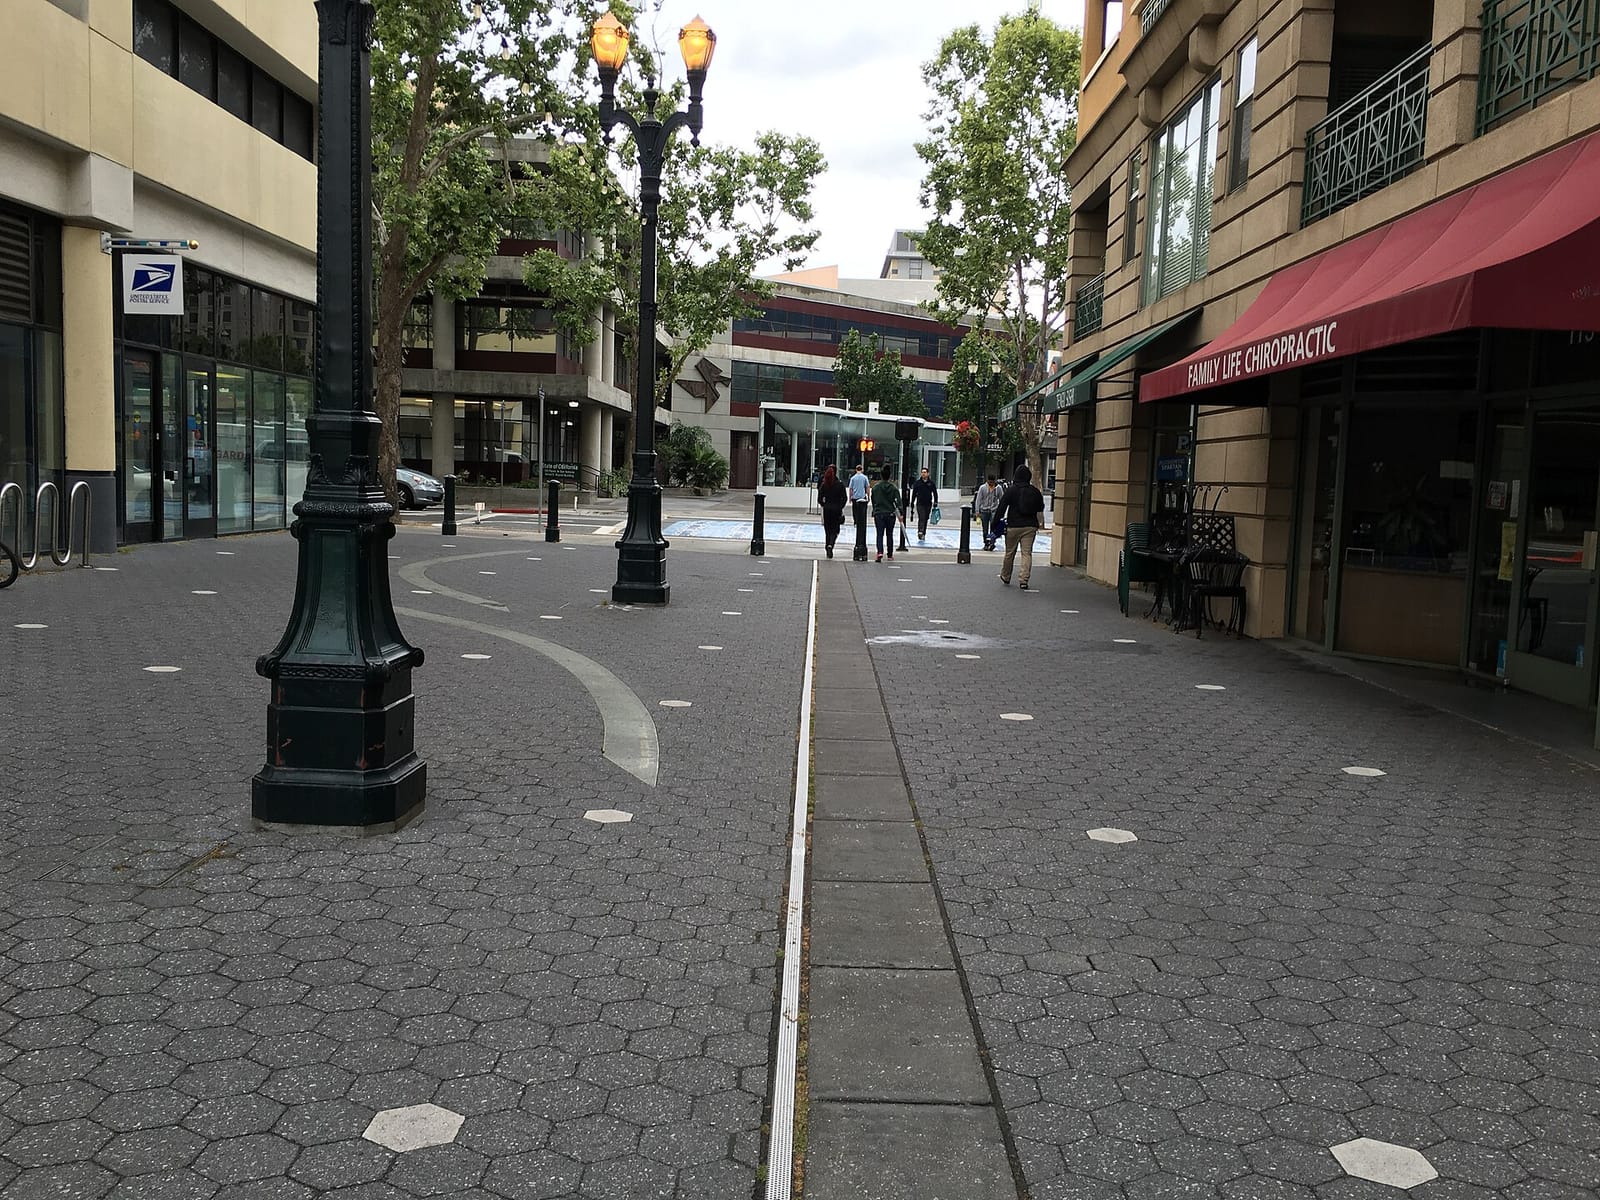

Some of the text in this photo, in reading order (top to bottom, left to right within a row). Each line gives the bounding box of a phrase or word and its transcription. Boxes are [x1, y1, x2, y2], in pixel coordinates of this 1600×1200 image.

[1187, 321, 1337, 388] FAMILY LIFE CHIROPRACTIC
